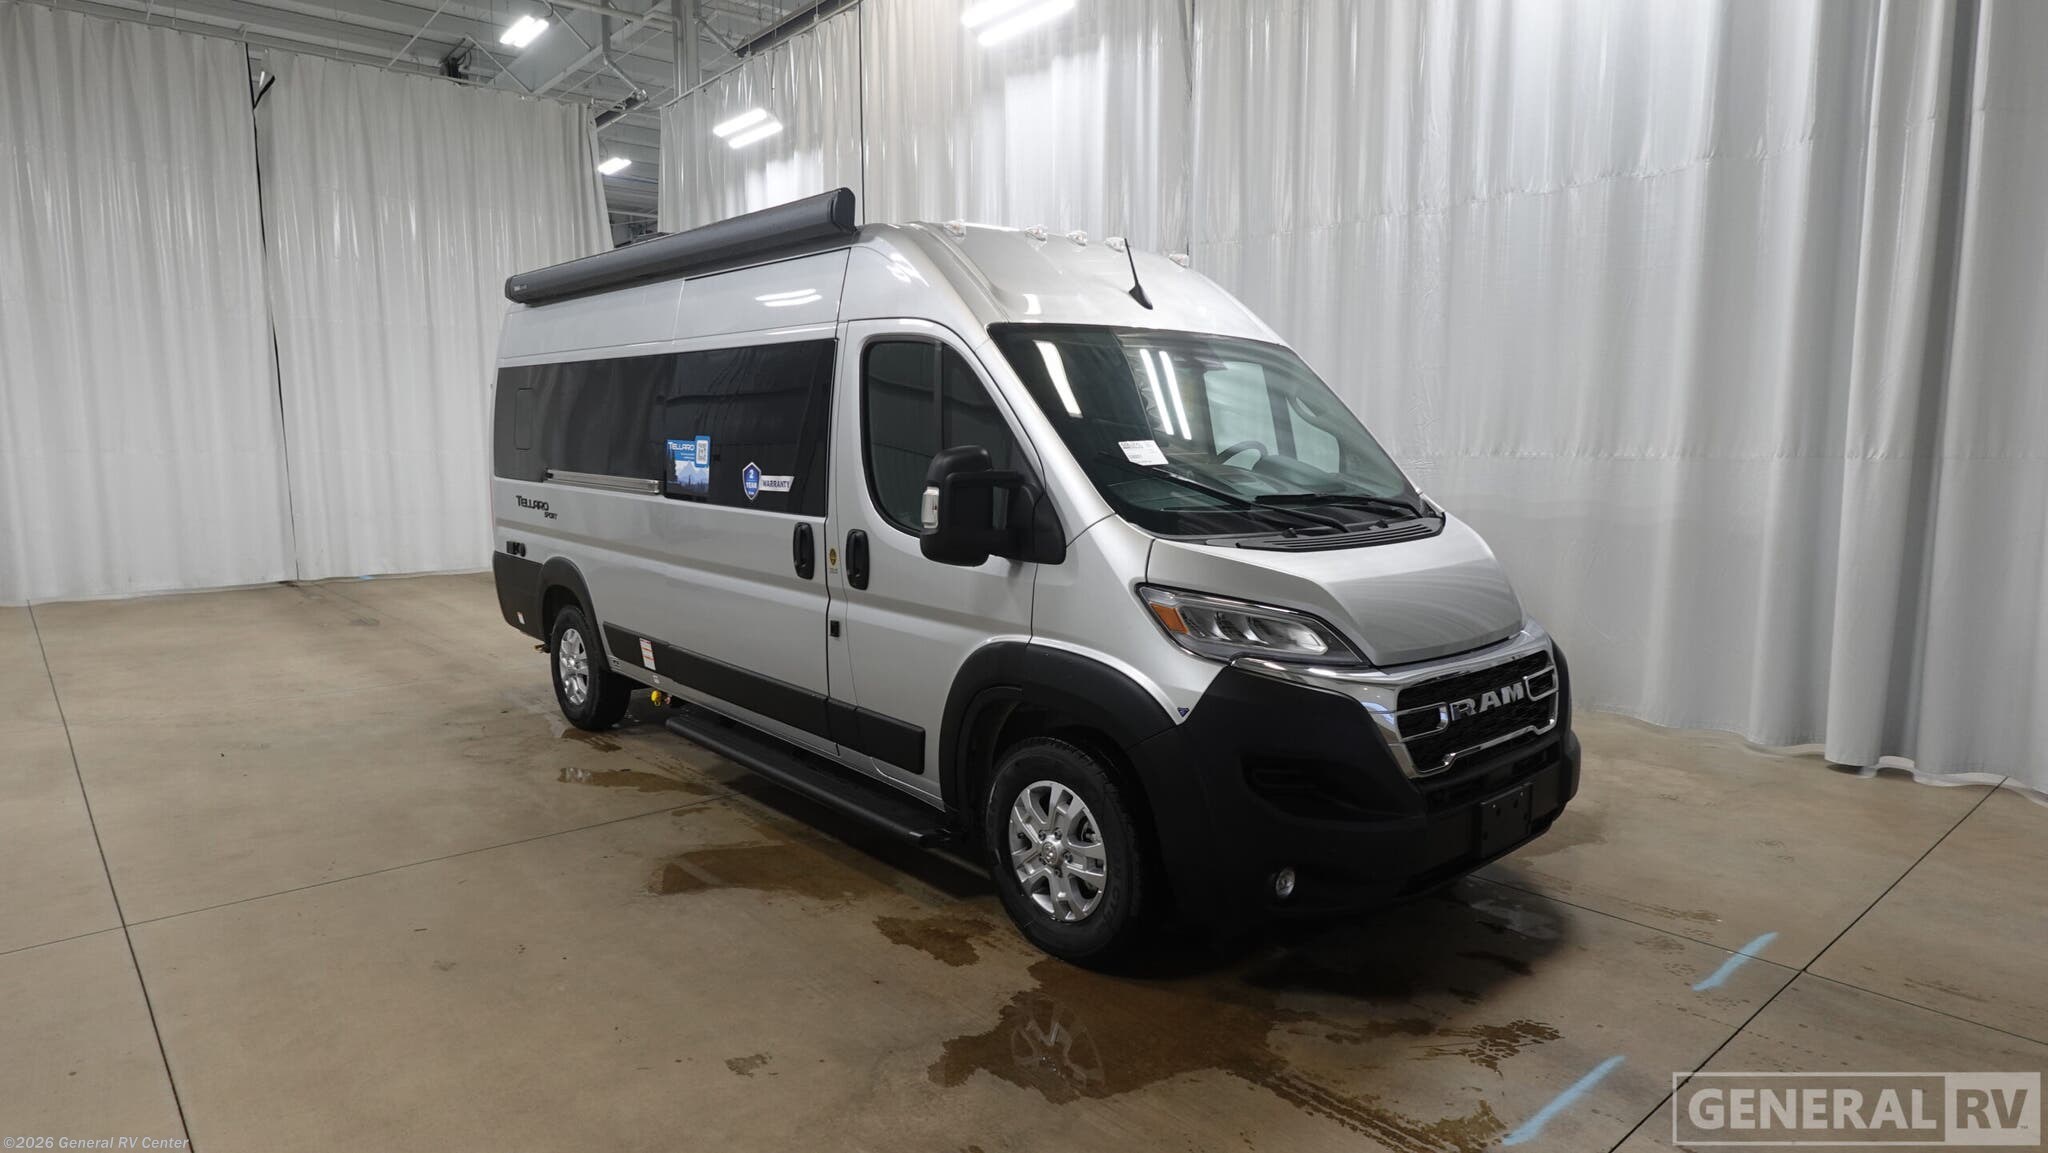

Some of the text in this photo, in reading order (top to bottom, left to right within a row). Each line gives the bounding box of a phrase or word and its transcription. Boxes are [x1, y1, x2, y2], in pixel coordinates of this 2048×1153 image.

[668, 441, 695, 451] TELLARO
[748, 469, 754, 479] 2
[762, 480, 790, 489] WARRANTY
[515, 495, 549, 511] TELLARO
[1449, 682, 1524, 721] RAM
